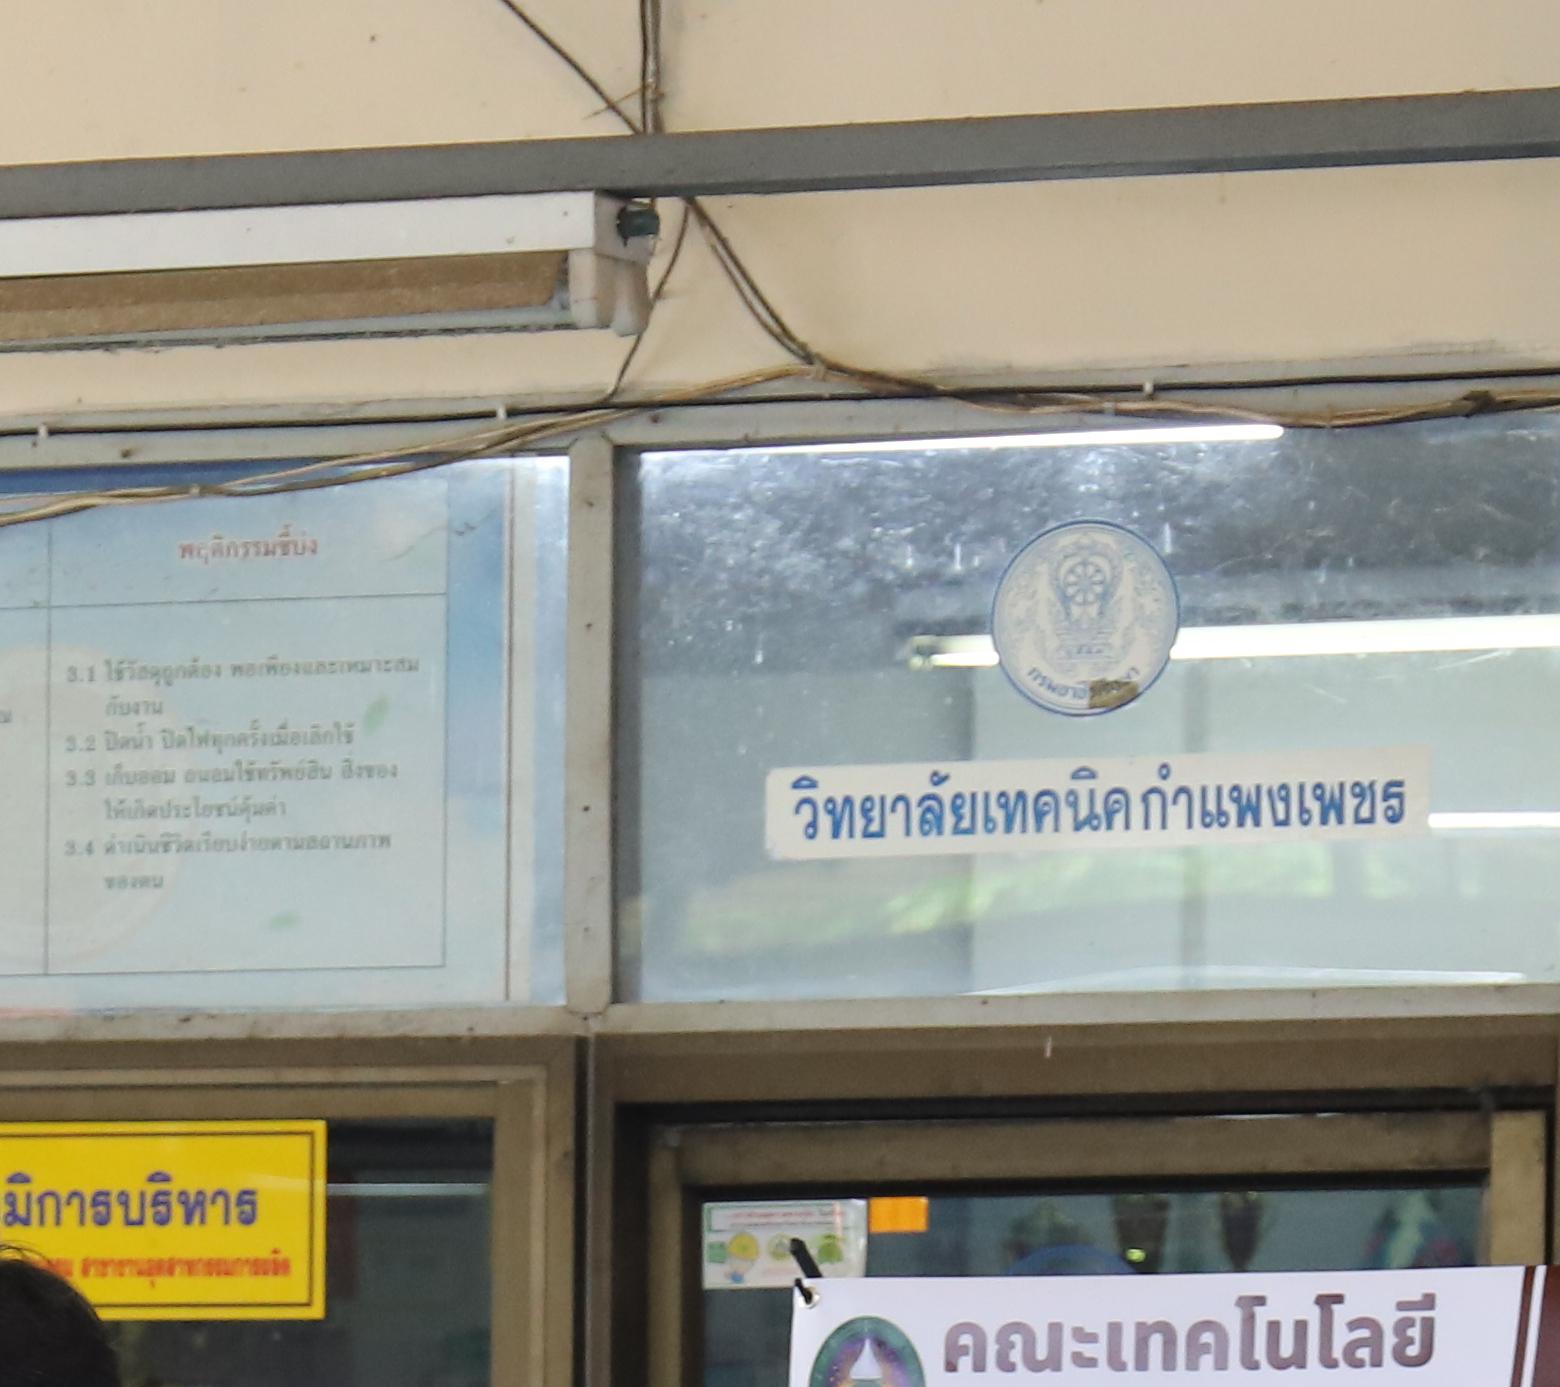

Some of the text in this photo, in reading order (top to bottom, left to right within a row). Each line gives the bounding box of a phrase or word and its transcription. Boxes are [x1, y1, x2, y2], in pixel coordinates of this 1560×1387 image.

[942, 1292, 1440, 1375] คณะเทคโนโลยี
